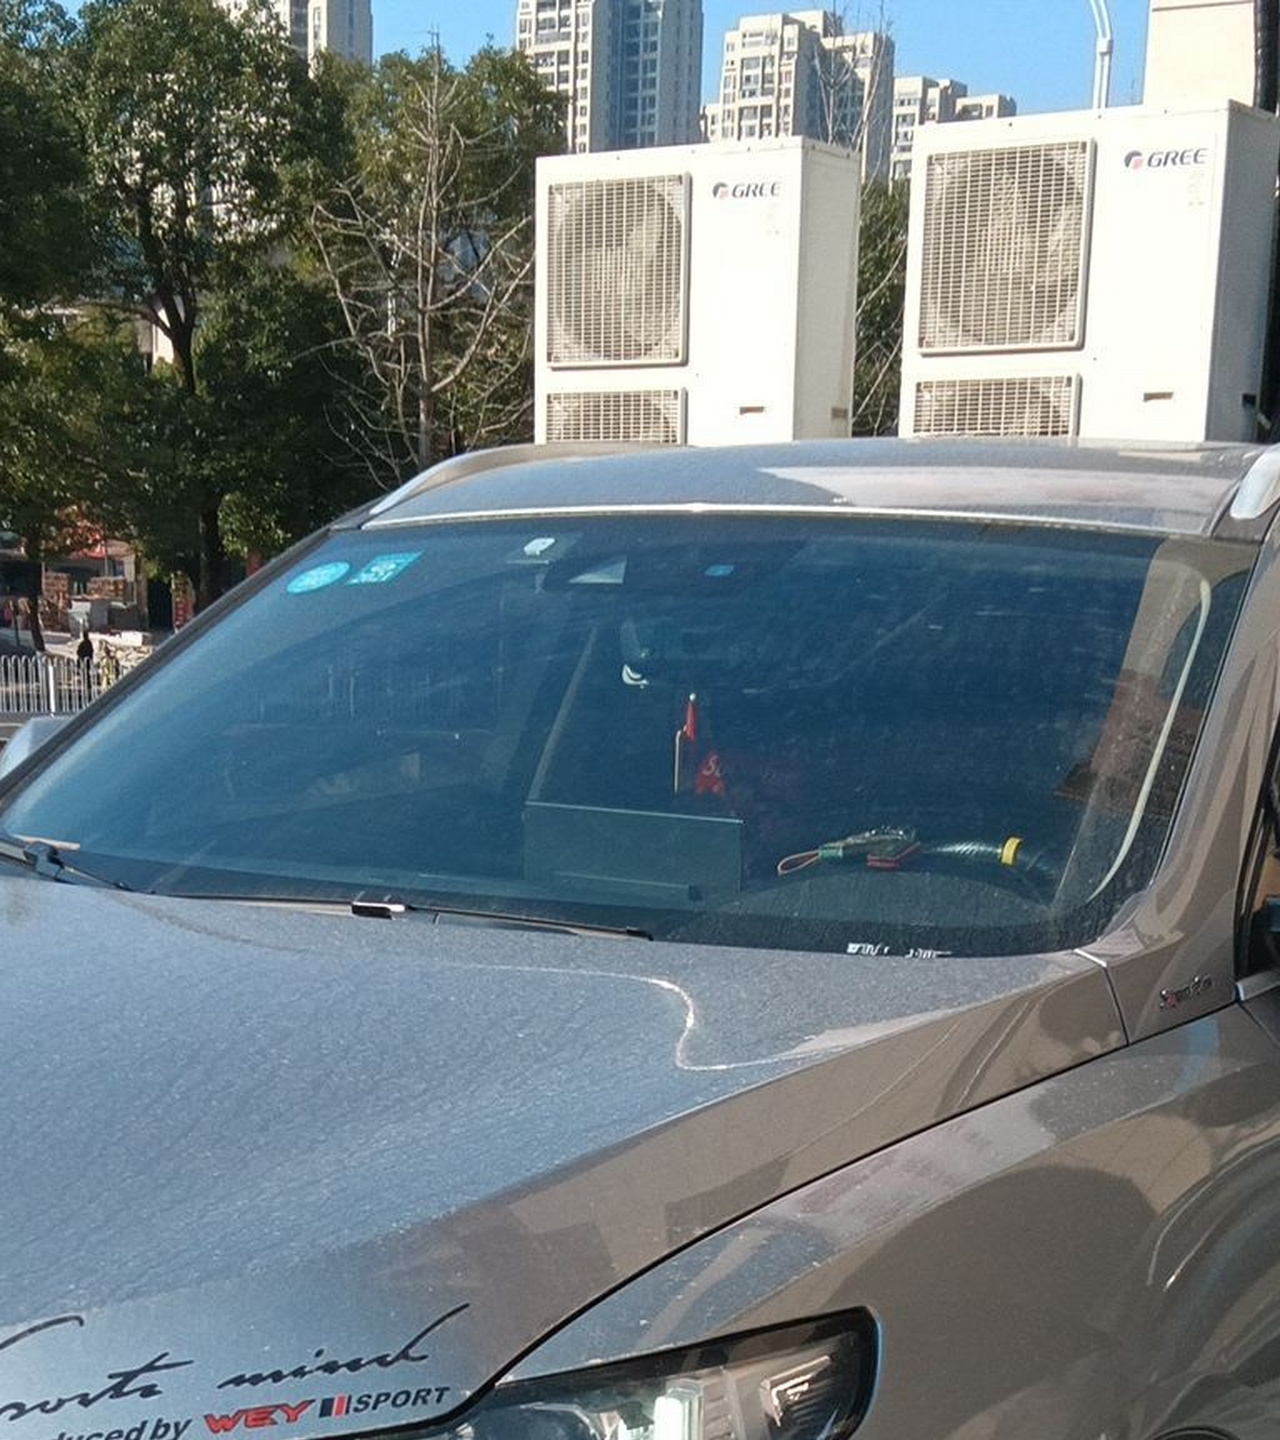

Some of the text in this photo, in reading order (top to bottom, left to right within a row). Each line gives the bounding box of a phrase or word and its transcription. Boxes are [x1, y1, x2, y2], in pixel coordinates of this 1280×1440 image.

[1147, 147, 1209, 168] GREE
[731, 181, 783, 199] GREE
[203, 1399, 317, 1436] WEY
[347, 1385, 451, 1415] SPORT
